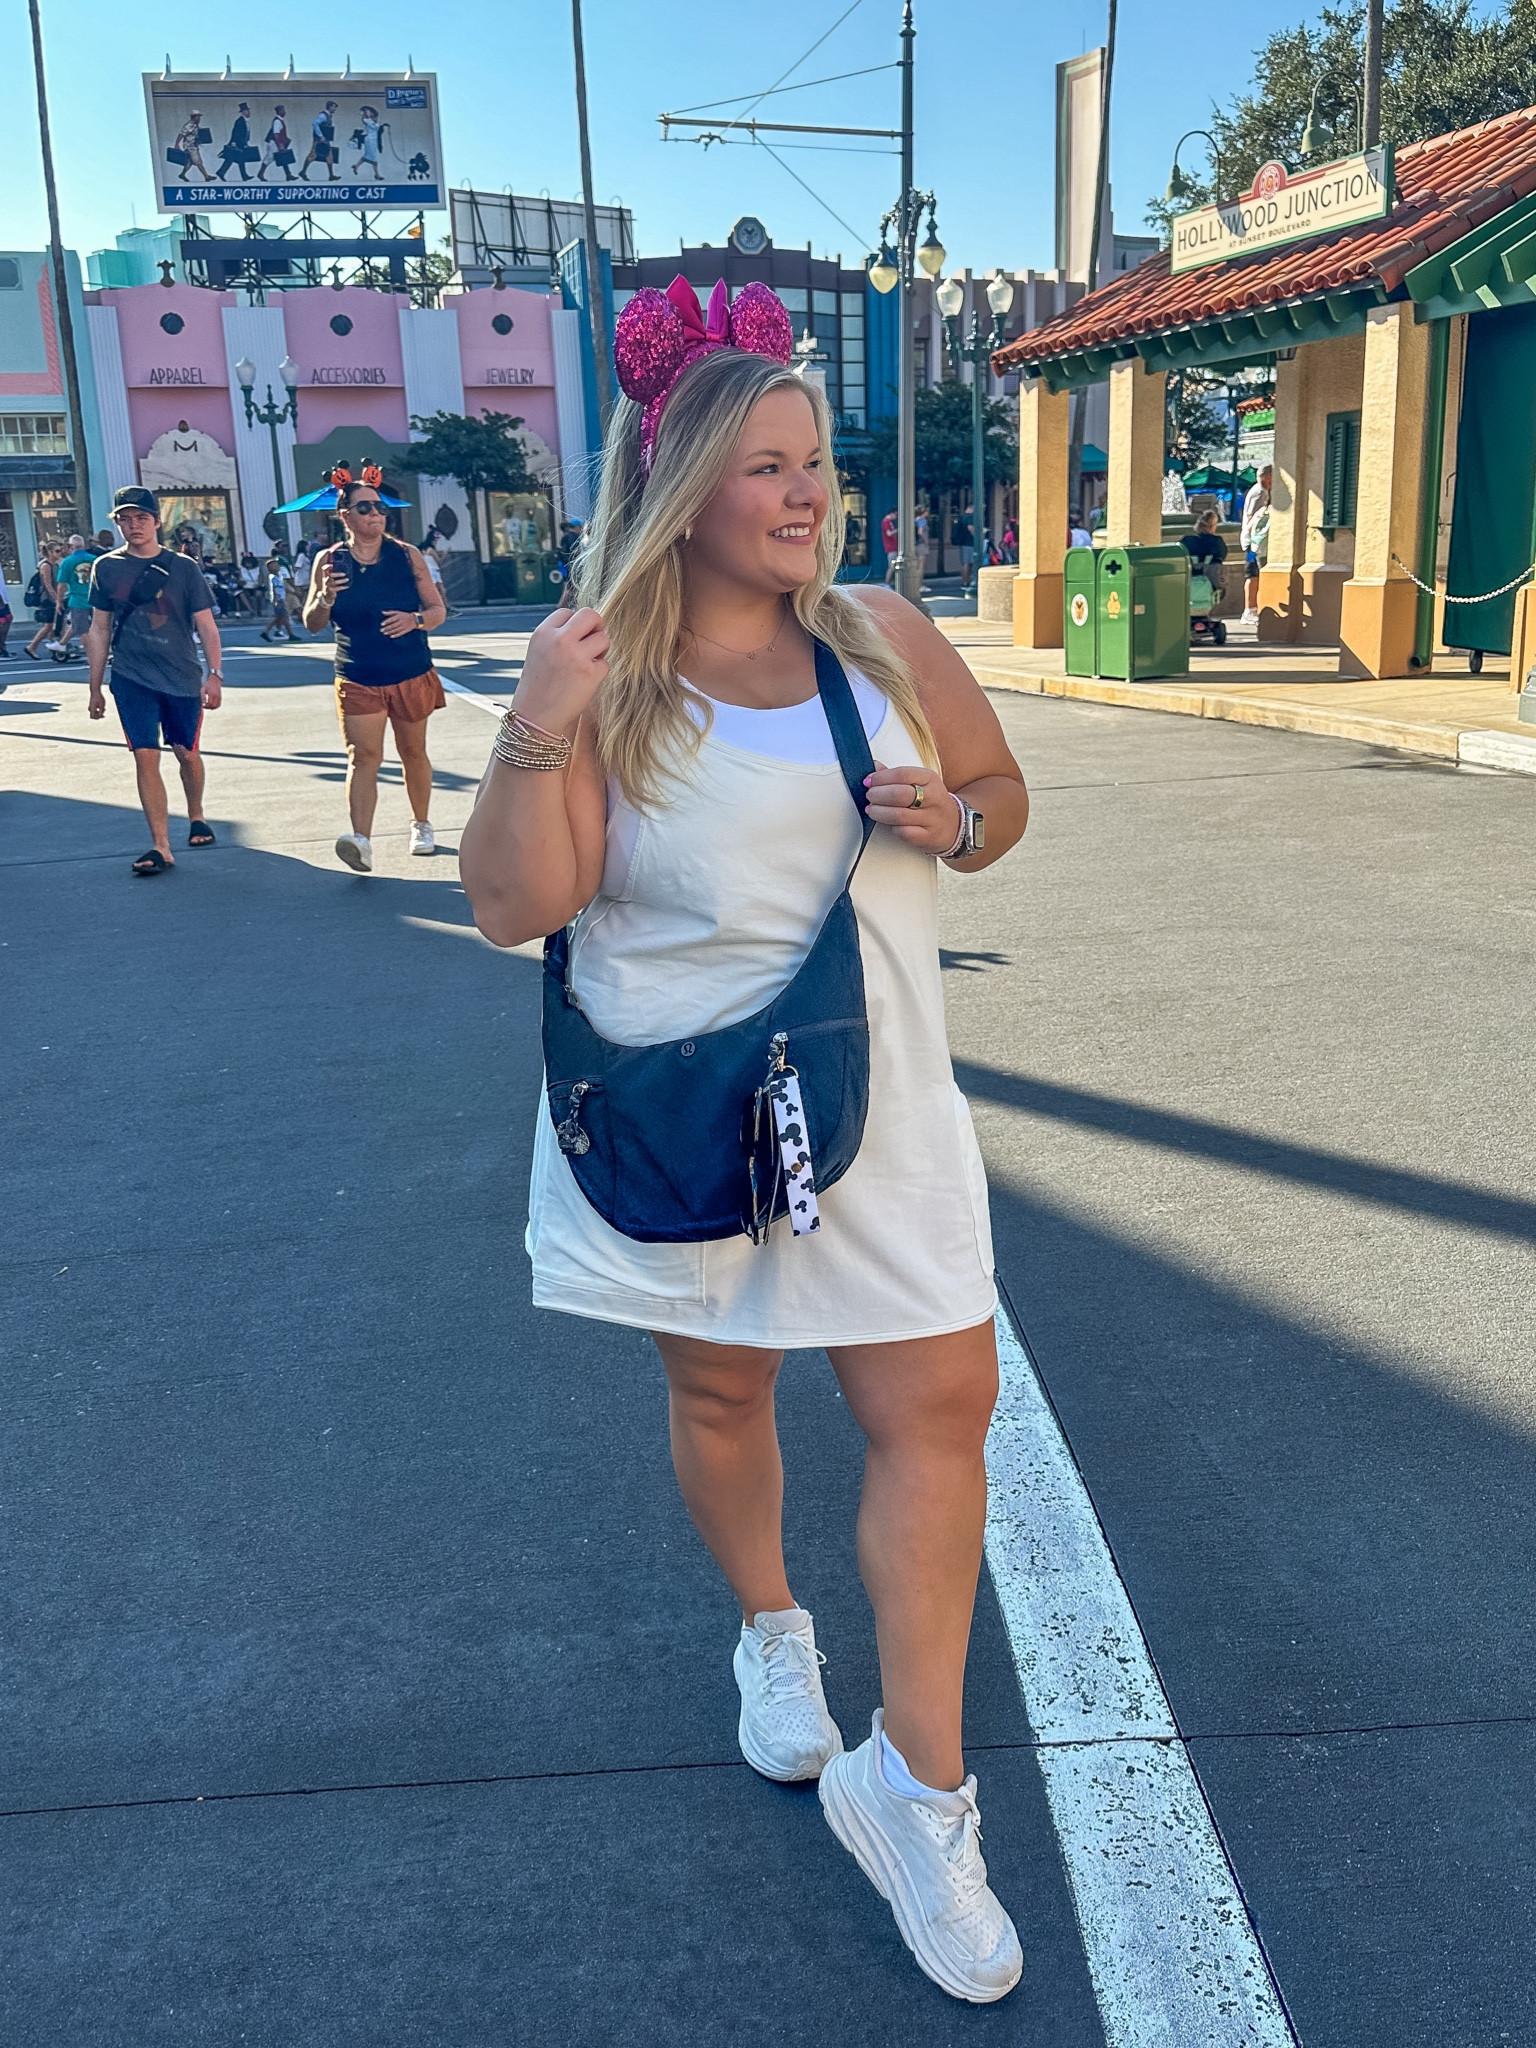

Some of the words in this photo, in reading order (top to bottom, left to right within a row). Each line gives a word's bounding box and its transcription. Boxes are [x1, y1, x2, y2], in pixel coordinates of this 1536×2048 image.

[175, 188, 184, 200] A
[190, 188, 271, 200] STAR-WORTHY
[277, 187, 350, 200] SUPPORTING
[355, 187, 387, 200] CAST
[1177, 201, 1278, 251] HOLLYWOOD
[1285, 168, 1379, 219] JUNCTION
[1229, 239, 1239, 248] AT
[1239, 231, 1266, 246] SUNSET
[1268, 219, 1311, 237] BOULEVARD
[150, 367, 207, 385] APPAREL
[311, 367, 386, 385] ACCESSORIES
[486, 368, 535, 385] JEWELRY
